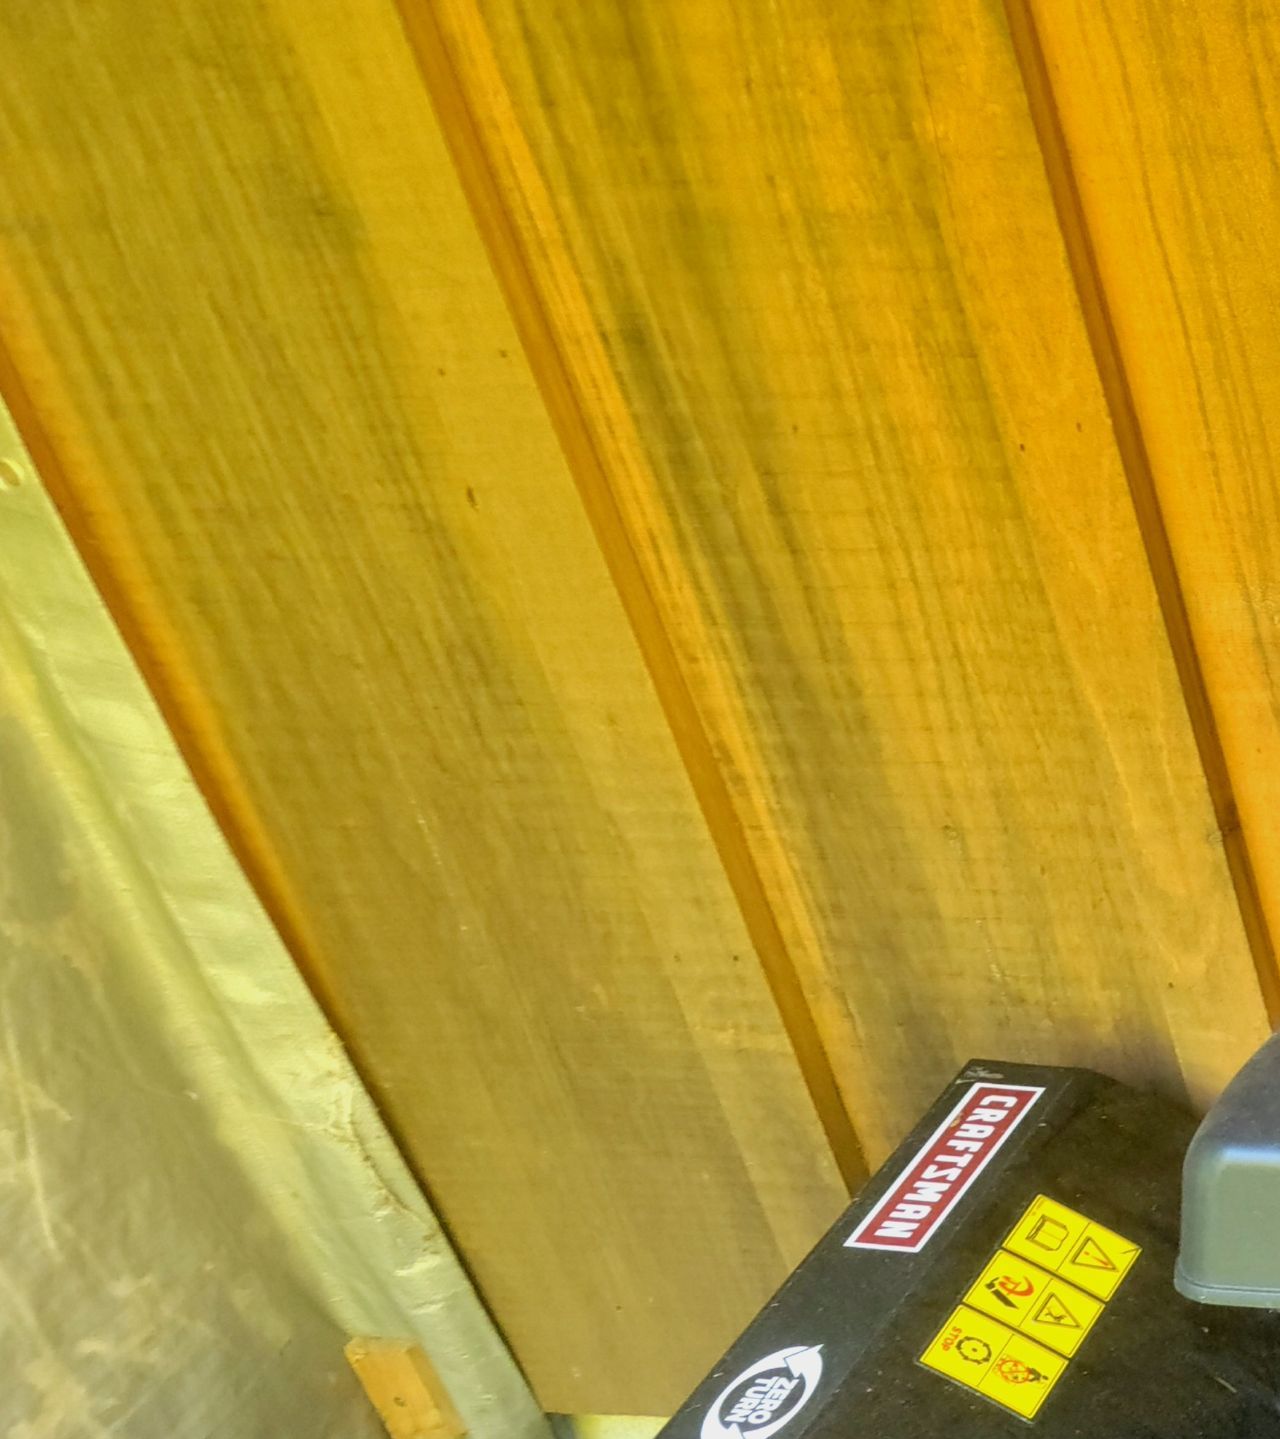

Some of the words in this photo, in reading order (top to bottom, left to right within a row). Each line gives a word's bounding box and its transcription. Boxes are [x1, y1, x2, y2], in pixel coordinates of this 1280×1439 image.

[874, 1095, 1018, 1239] CRAFTSMAN
[942, 1326, 962, 1352] STOP
[724, 1375, 779, 1423] TURN
[748, 1376, 800, 1425] ZERO
